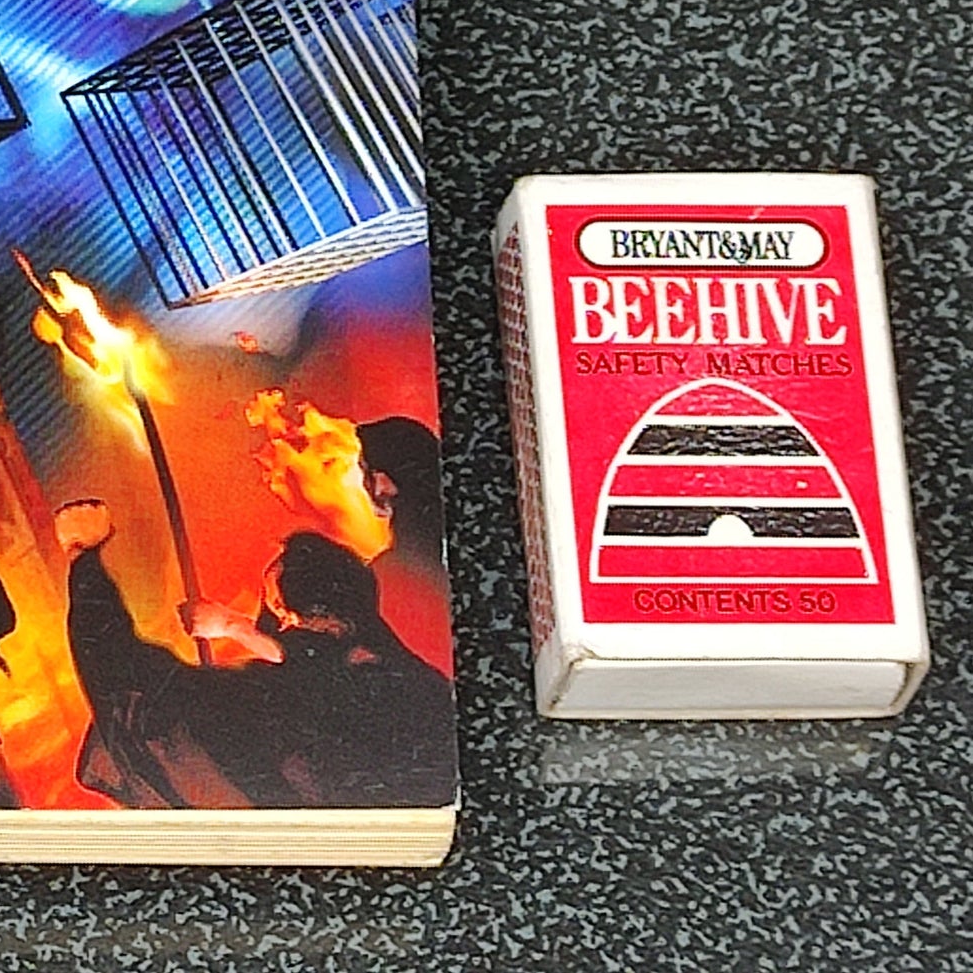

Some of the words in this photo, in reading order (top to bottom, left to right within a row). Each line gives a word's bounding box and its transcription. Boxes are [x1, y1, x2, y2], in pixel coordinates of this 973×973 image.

[568, 276, 847, 345] BEEHIVE
[575, 352, 687, 375] SAFETY
[706, 353, 853, 376] MATCHES
[633, 588, 792, 613] CONTENTS
[798, 591, 836, 613] 50
